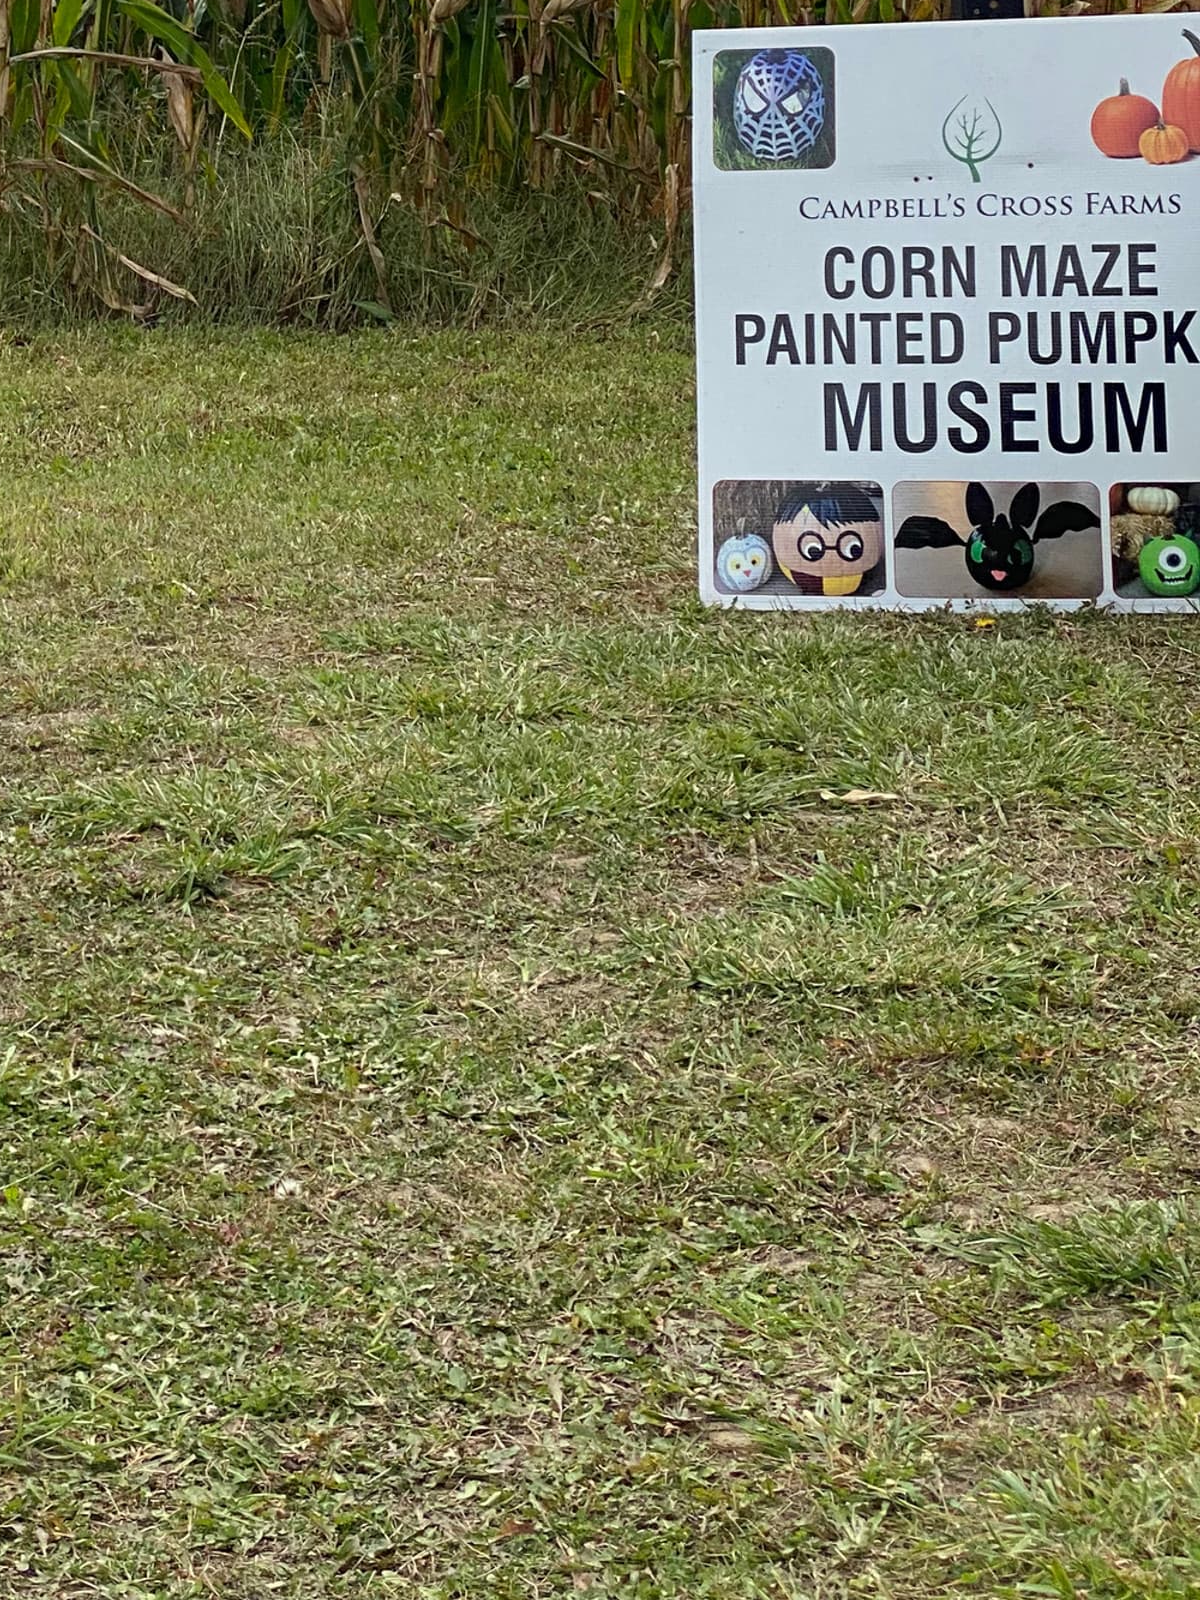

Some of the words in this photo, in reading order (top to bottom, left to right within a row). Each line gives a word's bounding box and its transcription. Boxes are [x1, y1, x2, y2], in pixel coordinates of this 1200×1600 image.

[975, 192, 1074, 218] CROSS
[1085, 192, 1182, 216] FARMS
[824, 245, 976, 300] CORN
[1000, 243, 1159, 297] MAZE
[735, 312, 964, 366] PAINTED
[988, 310, 1200, 365] PUMPK
[823, 381, 1168, 455] MUSEUM
